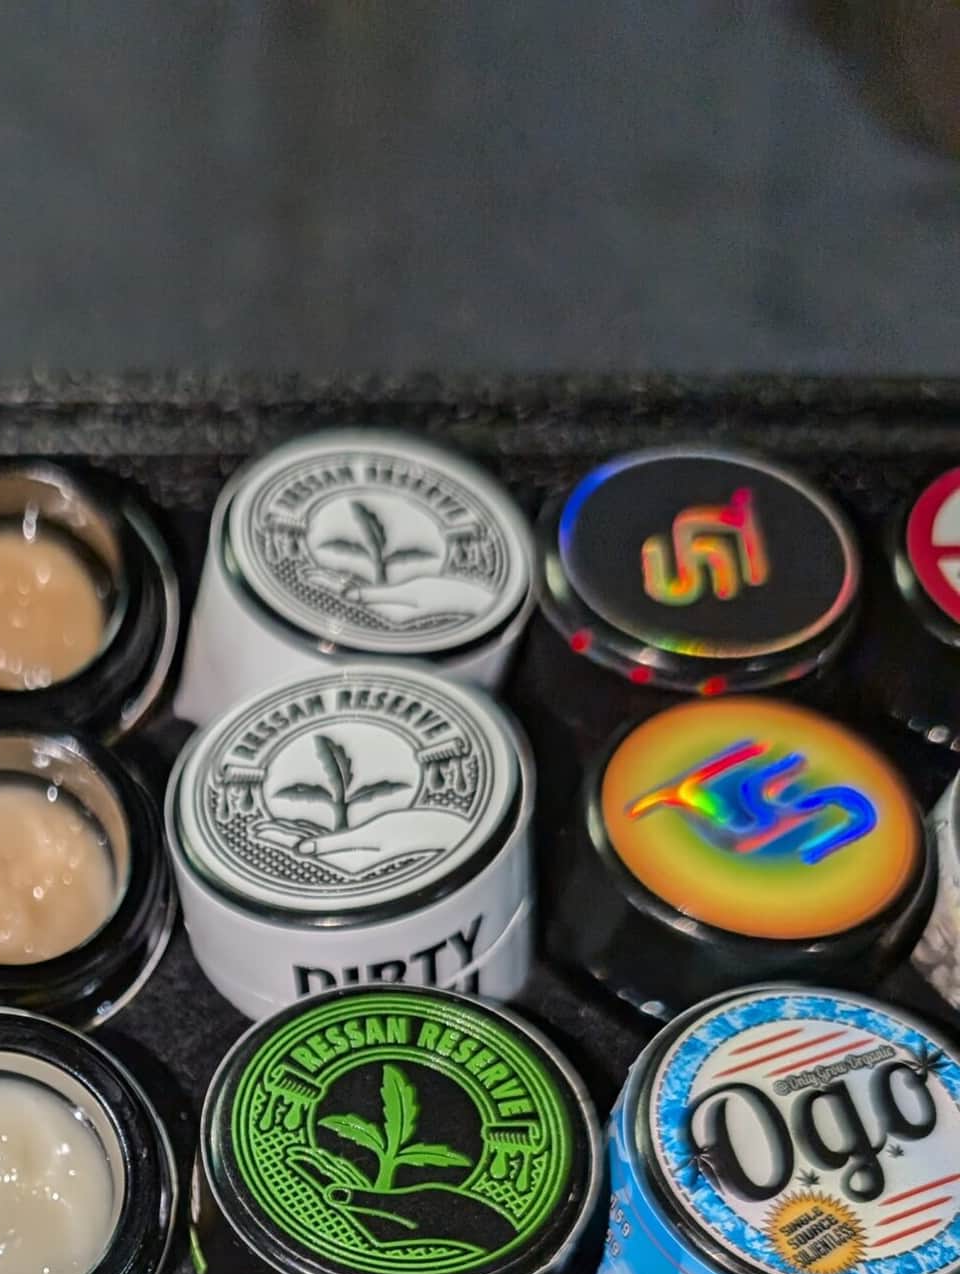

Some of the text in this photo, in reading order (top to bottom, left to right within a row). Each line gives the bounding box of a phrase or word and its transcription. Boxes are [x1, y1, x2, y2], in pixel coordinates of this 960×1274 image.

[230, 688, 451, 761] RESSAN RESERVE
[292, 913, 484, 997] DRTY
[290, 1016, 534, 1117] RESSAN RESERVE
[779, 1206, 825, 1235] SINGLE
[788, 1214, 839, 1249] SOURCE
